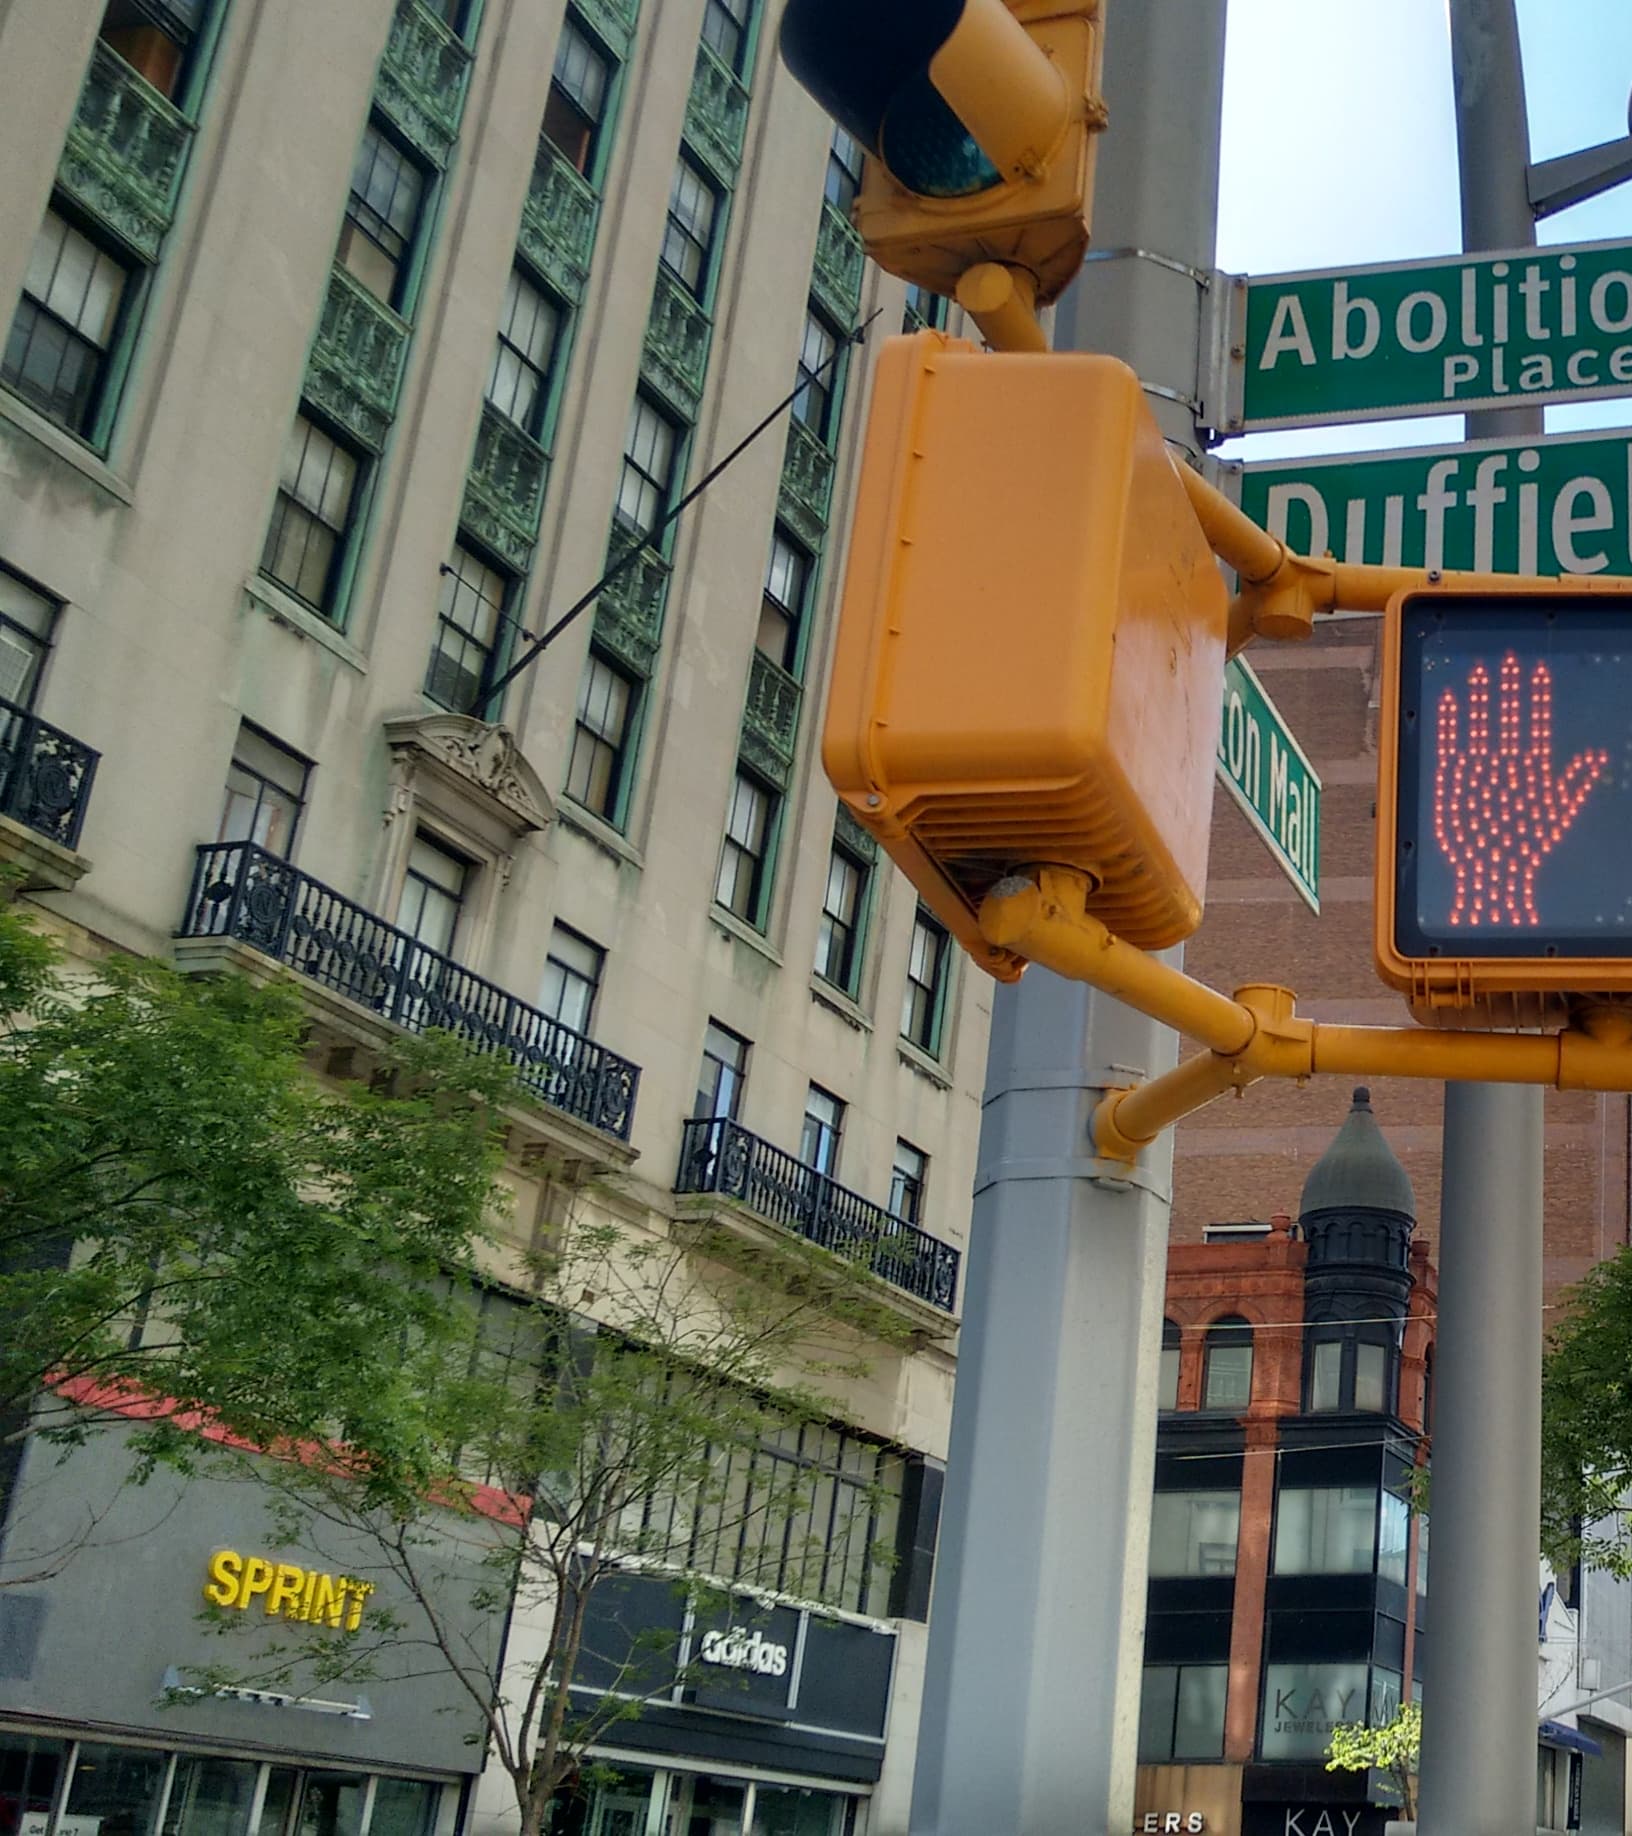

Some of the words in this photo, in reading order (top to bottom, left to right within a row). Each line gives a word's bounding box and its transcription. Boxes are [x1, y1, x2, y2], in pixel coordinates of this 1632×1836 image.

[1268, 730, 1317, 893] Mall
[205, 1550, 375, 1631] SPRINT
[702, 1627, 787, 1676] adidas
[1275, 1688, 1356, 1719] KAY
[1285, 1807, 1361, 1836] KAY
